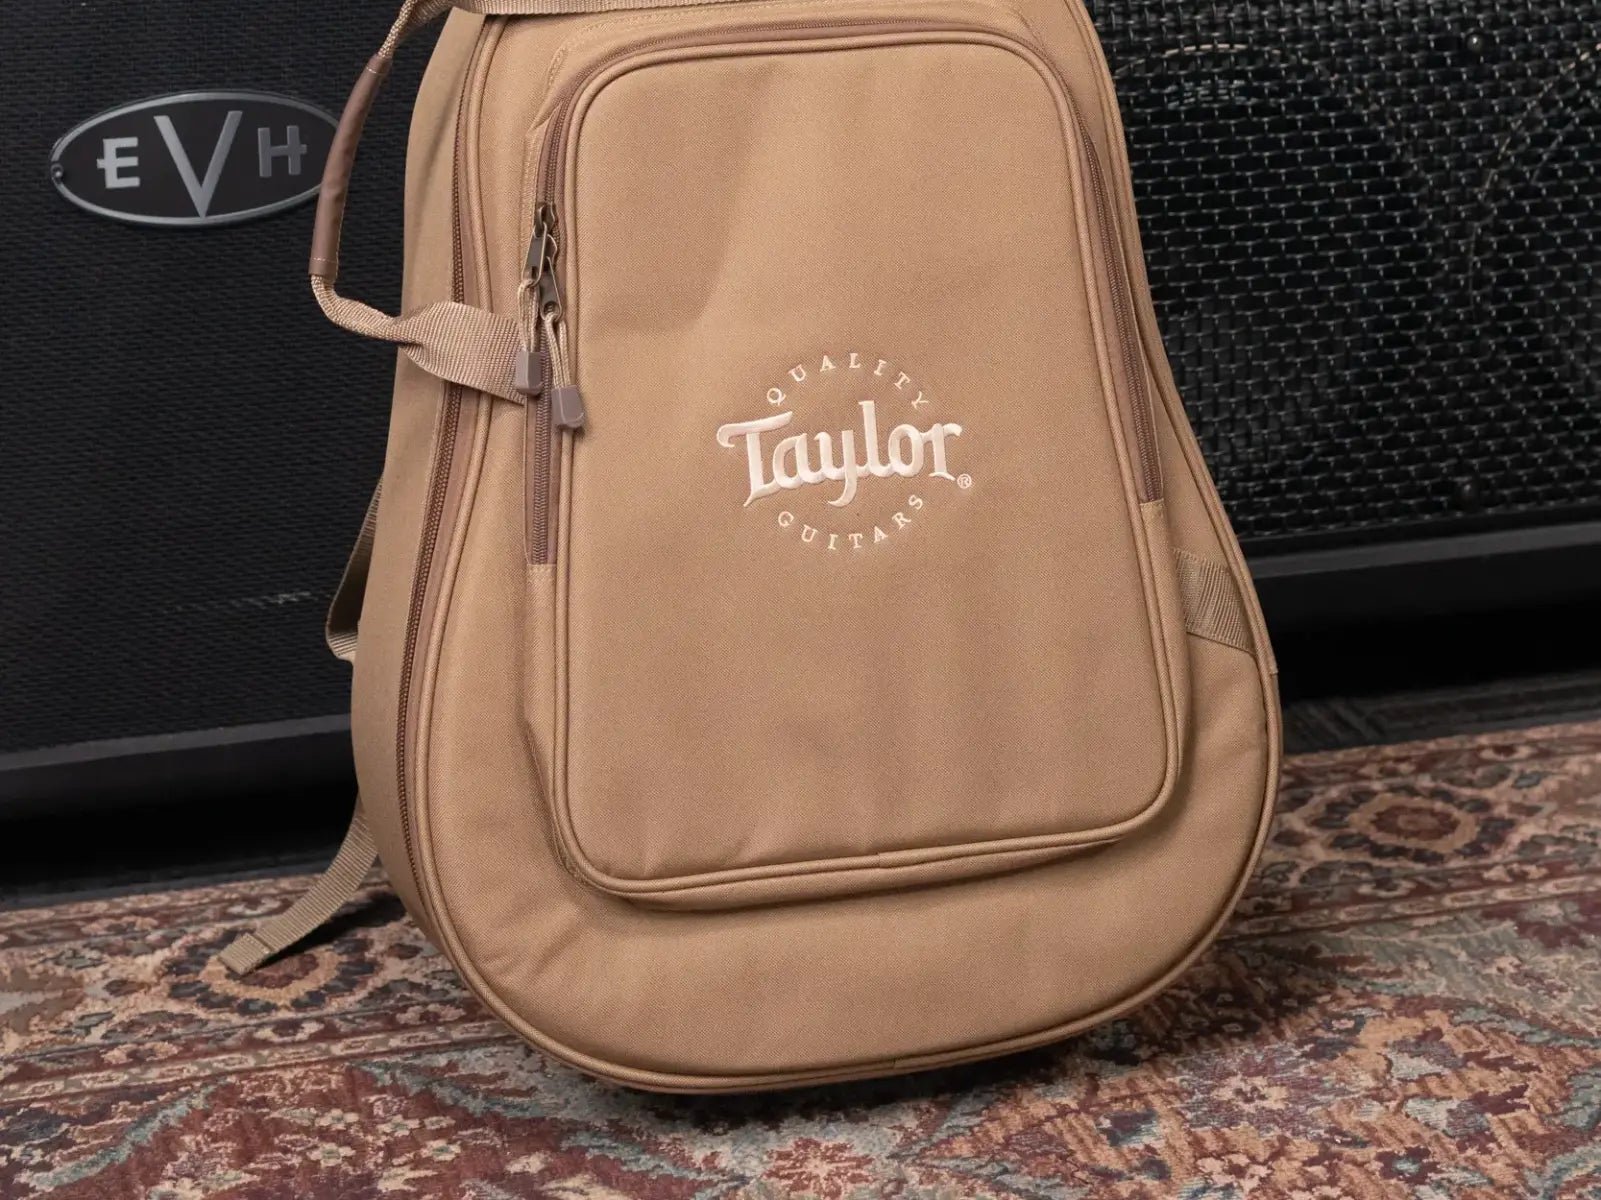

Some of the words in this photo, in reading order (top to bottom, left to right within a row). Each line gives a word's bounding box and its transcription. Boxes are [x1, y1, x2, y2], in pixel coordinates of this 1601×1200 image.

[97, 110, 307, 219] EVH
[766, 353, 930, 409] QUALITY
[777, 495, 924, 551] GUITARS
